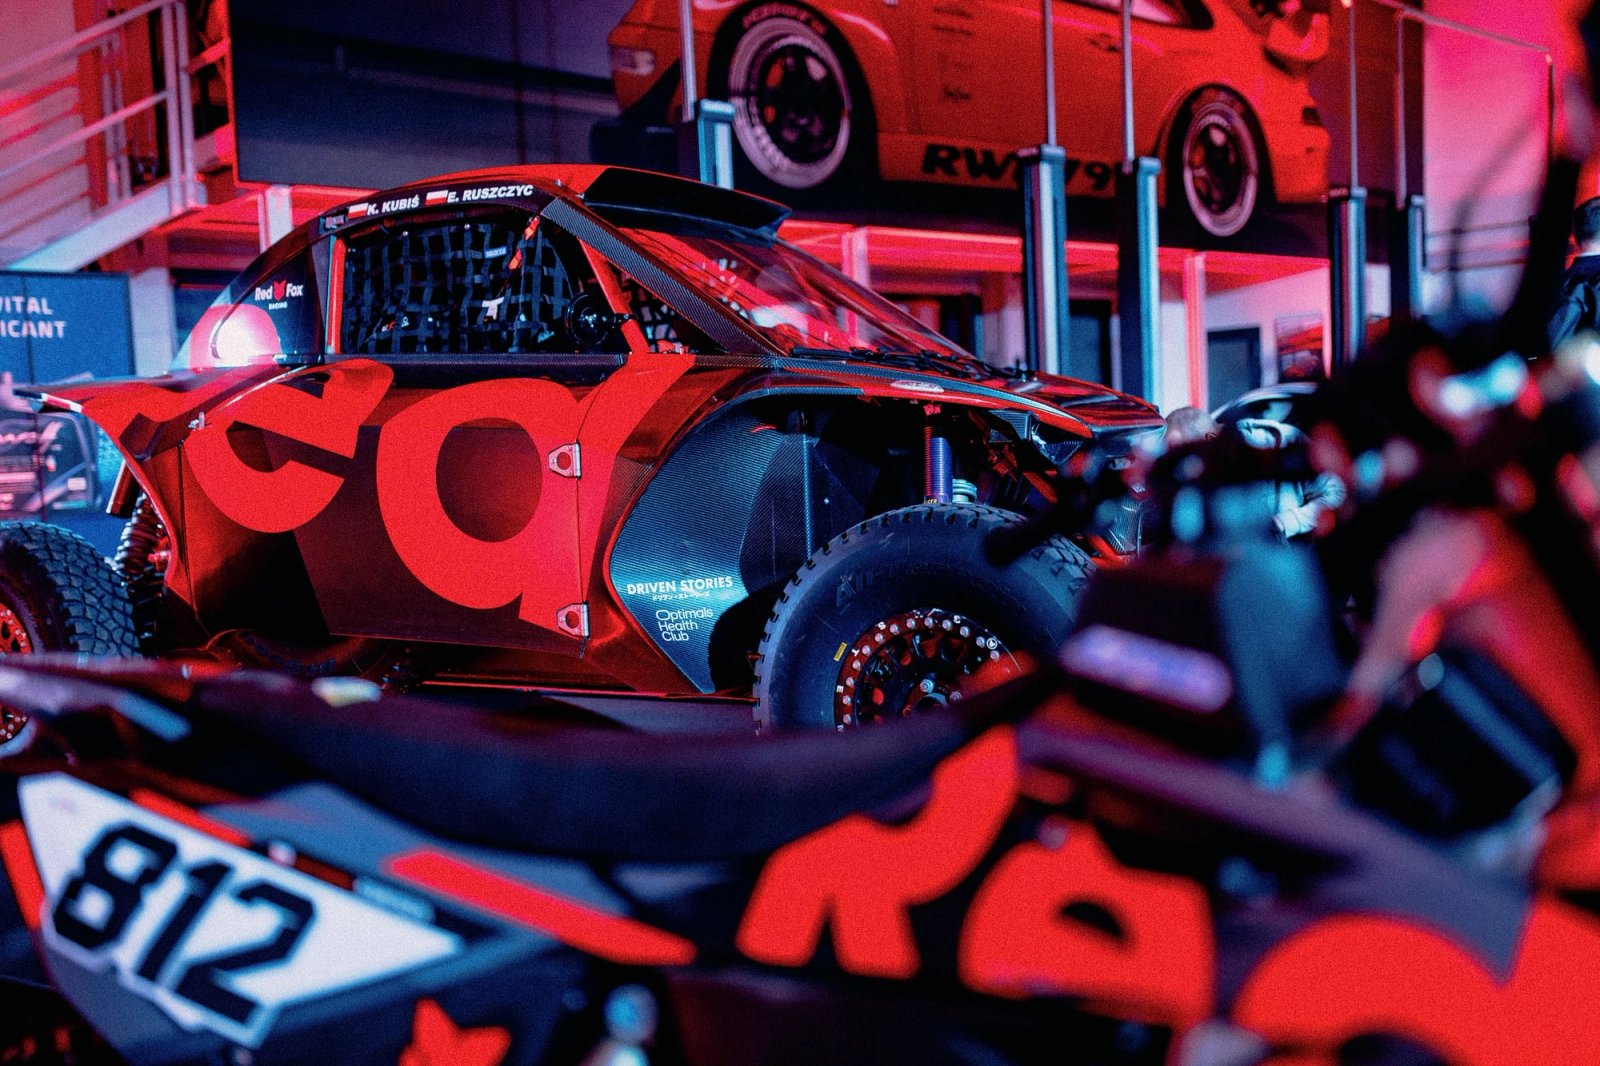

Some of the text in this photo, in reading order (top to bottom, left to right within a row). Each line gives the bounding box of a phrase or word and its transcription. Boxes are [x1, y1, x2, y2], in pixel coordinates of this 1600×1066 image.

[447, 184, 534, 204] E. RUSZCZYC
[367, 194, 420, 216] K. KUBIŚ
[254, 282, 304, 301] Red Fox
[0, 296, 53, 315] ITAL
[626, 575, 733, 595] DRIVEN STORIES
[655, 607, 714, 622] Optimals
[658, 620, 699, 632] Health
[662, 631, 690, 642] Club
[52, 820, 316, 1024] 812
